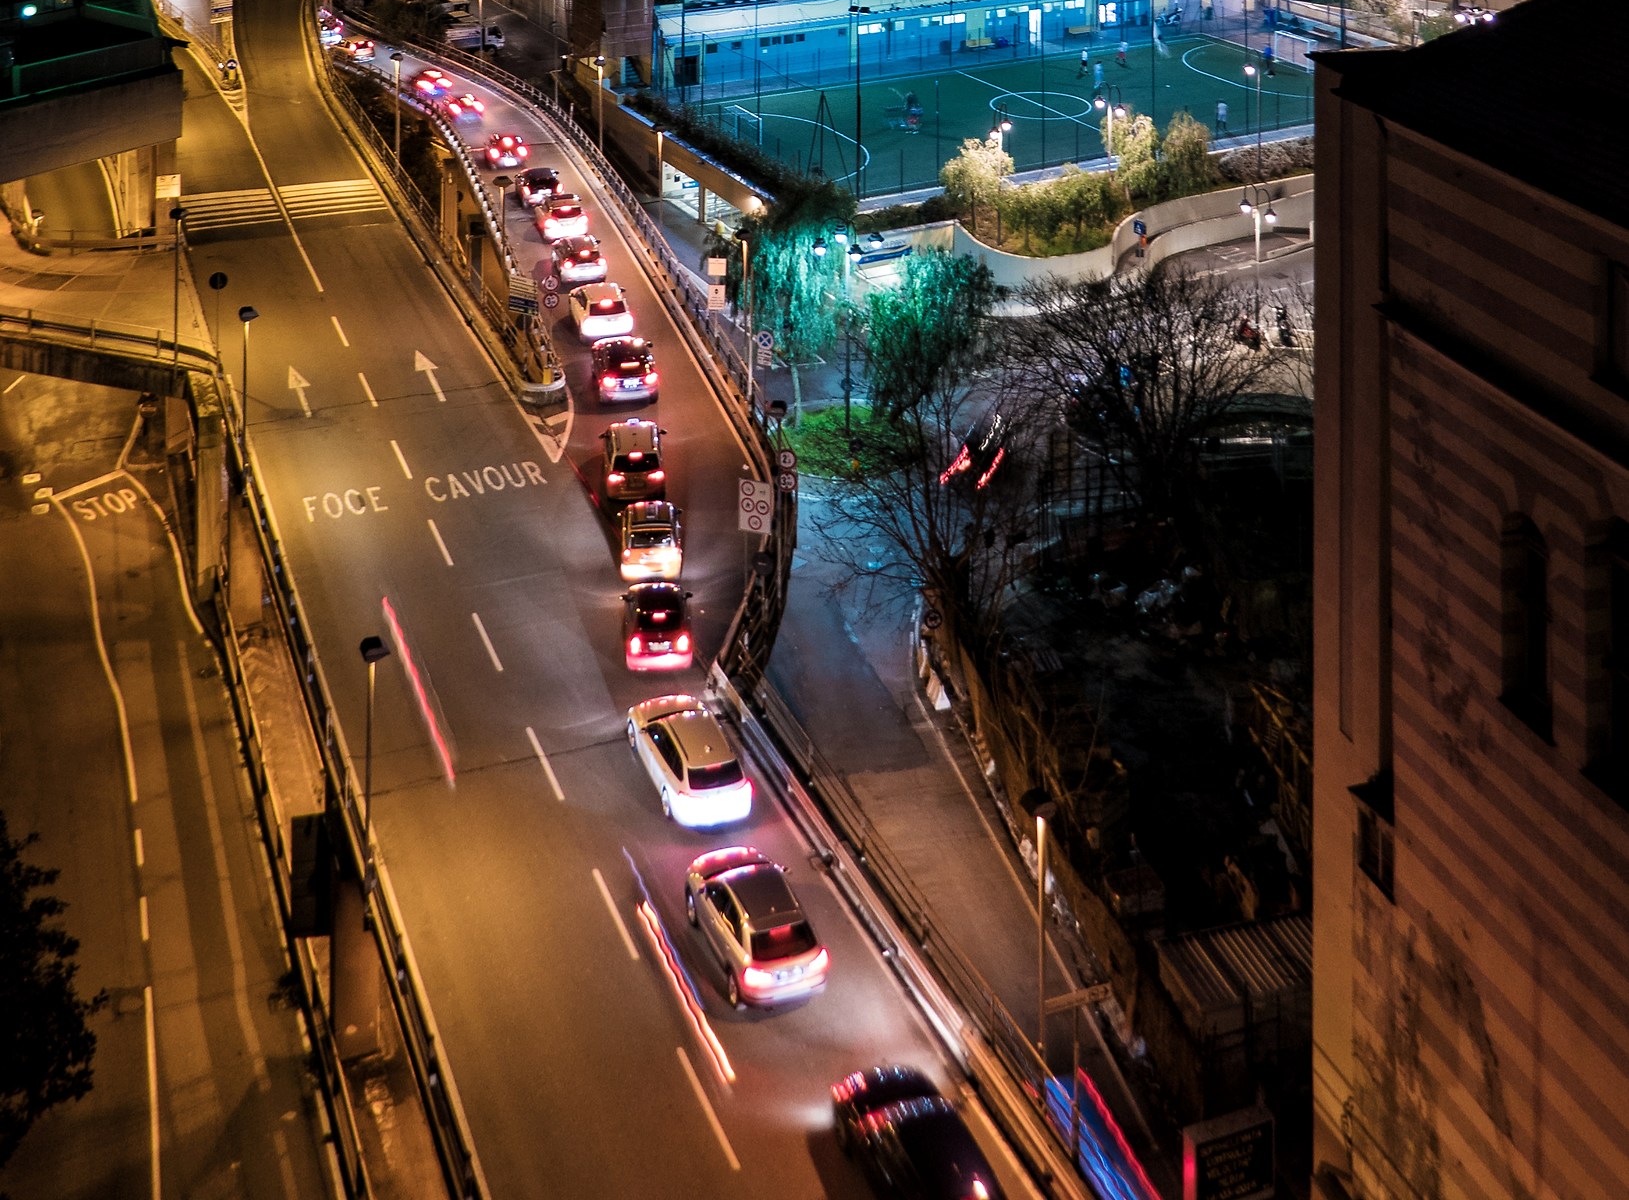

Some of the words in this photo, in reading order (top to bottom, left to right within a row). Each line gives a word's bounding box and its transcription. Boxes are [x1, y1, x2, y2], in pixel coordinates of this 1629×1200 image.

[72, 488, 137, 521] STOP
[302, 485, 389, 523] FOCE
[425, 461, 548, 502] CAVOUR
